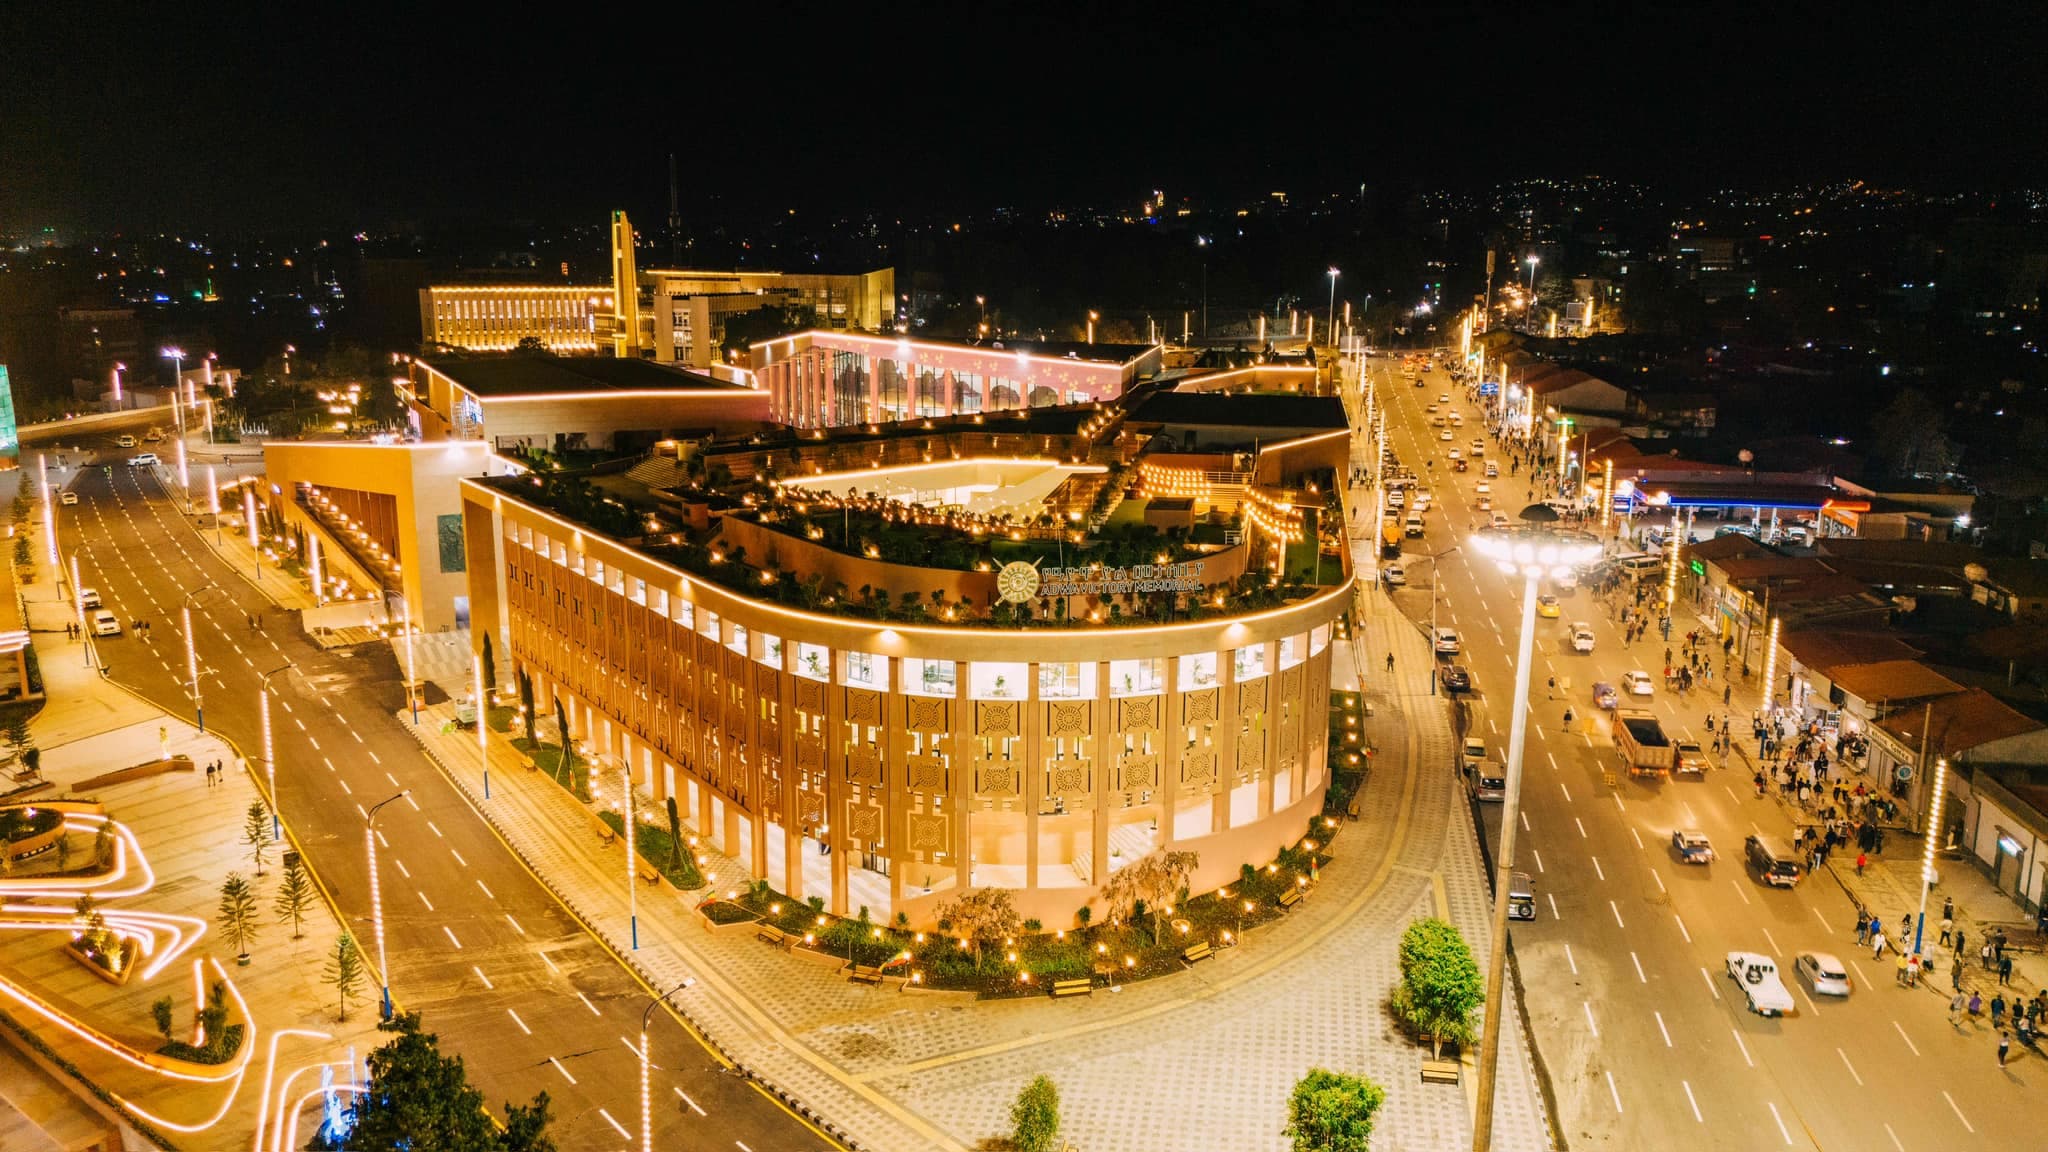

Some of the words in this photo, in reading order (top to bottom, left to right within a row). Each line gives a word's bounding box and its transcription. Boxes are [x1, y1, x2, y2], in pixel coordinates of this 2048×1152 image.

[1041, 582, 1079, 596] ADWA
[1080, 580, 1134, 594] VICTORY
[1135, 578, 1203, 593] MEMORIAL
